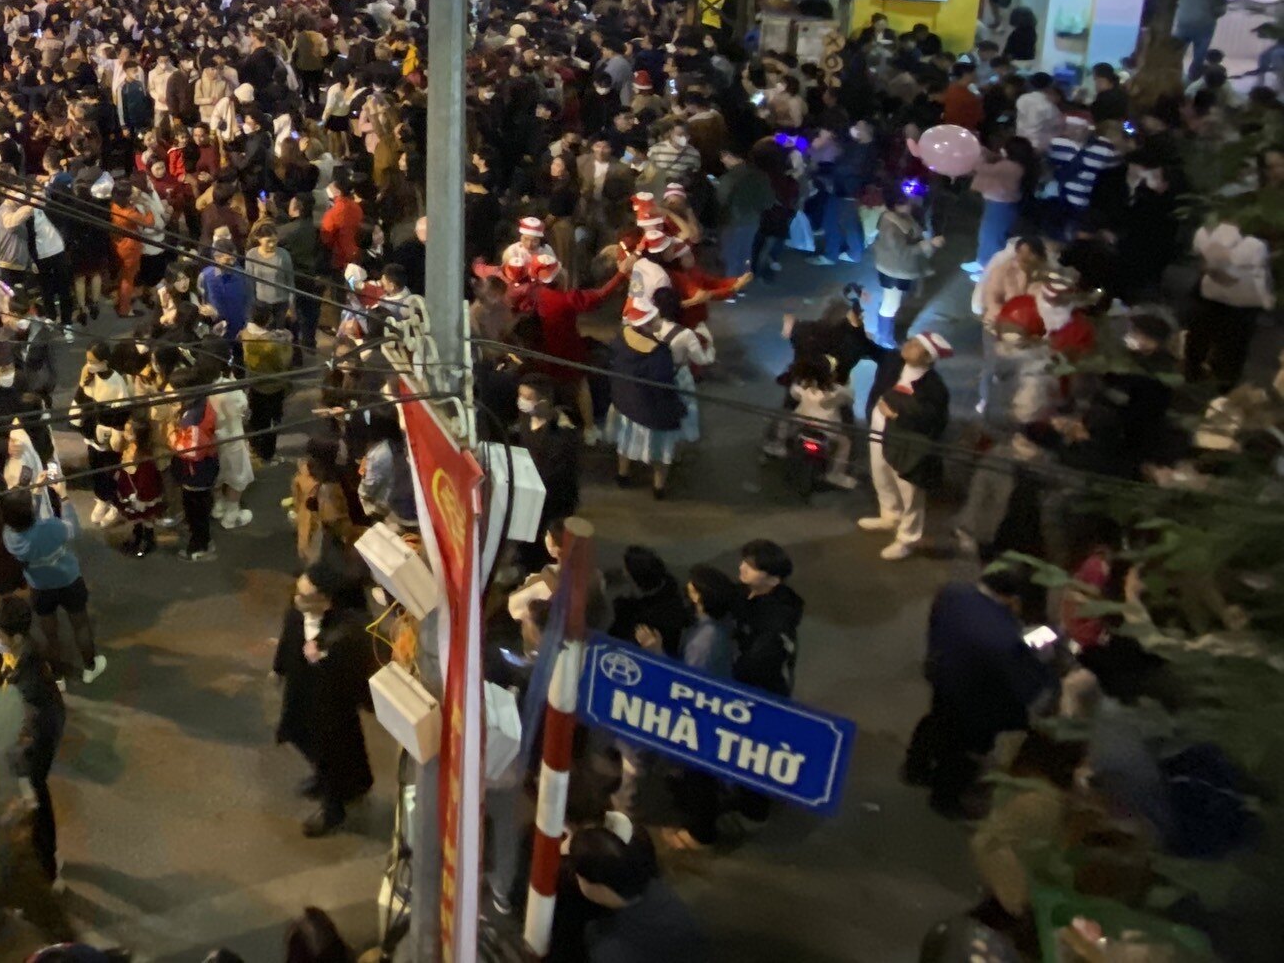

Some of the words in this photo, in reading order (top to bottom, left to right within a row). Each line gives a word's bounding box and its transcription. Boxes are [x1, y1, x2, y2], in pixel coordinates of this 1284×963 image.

[610, 689, 699, 752] NHÀ
[715, 727, 806, 786] THỜ
[669, 681, 756, 725] PHỐ
